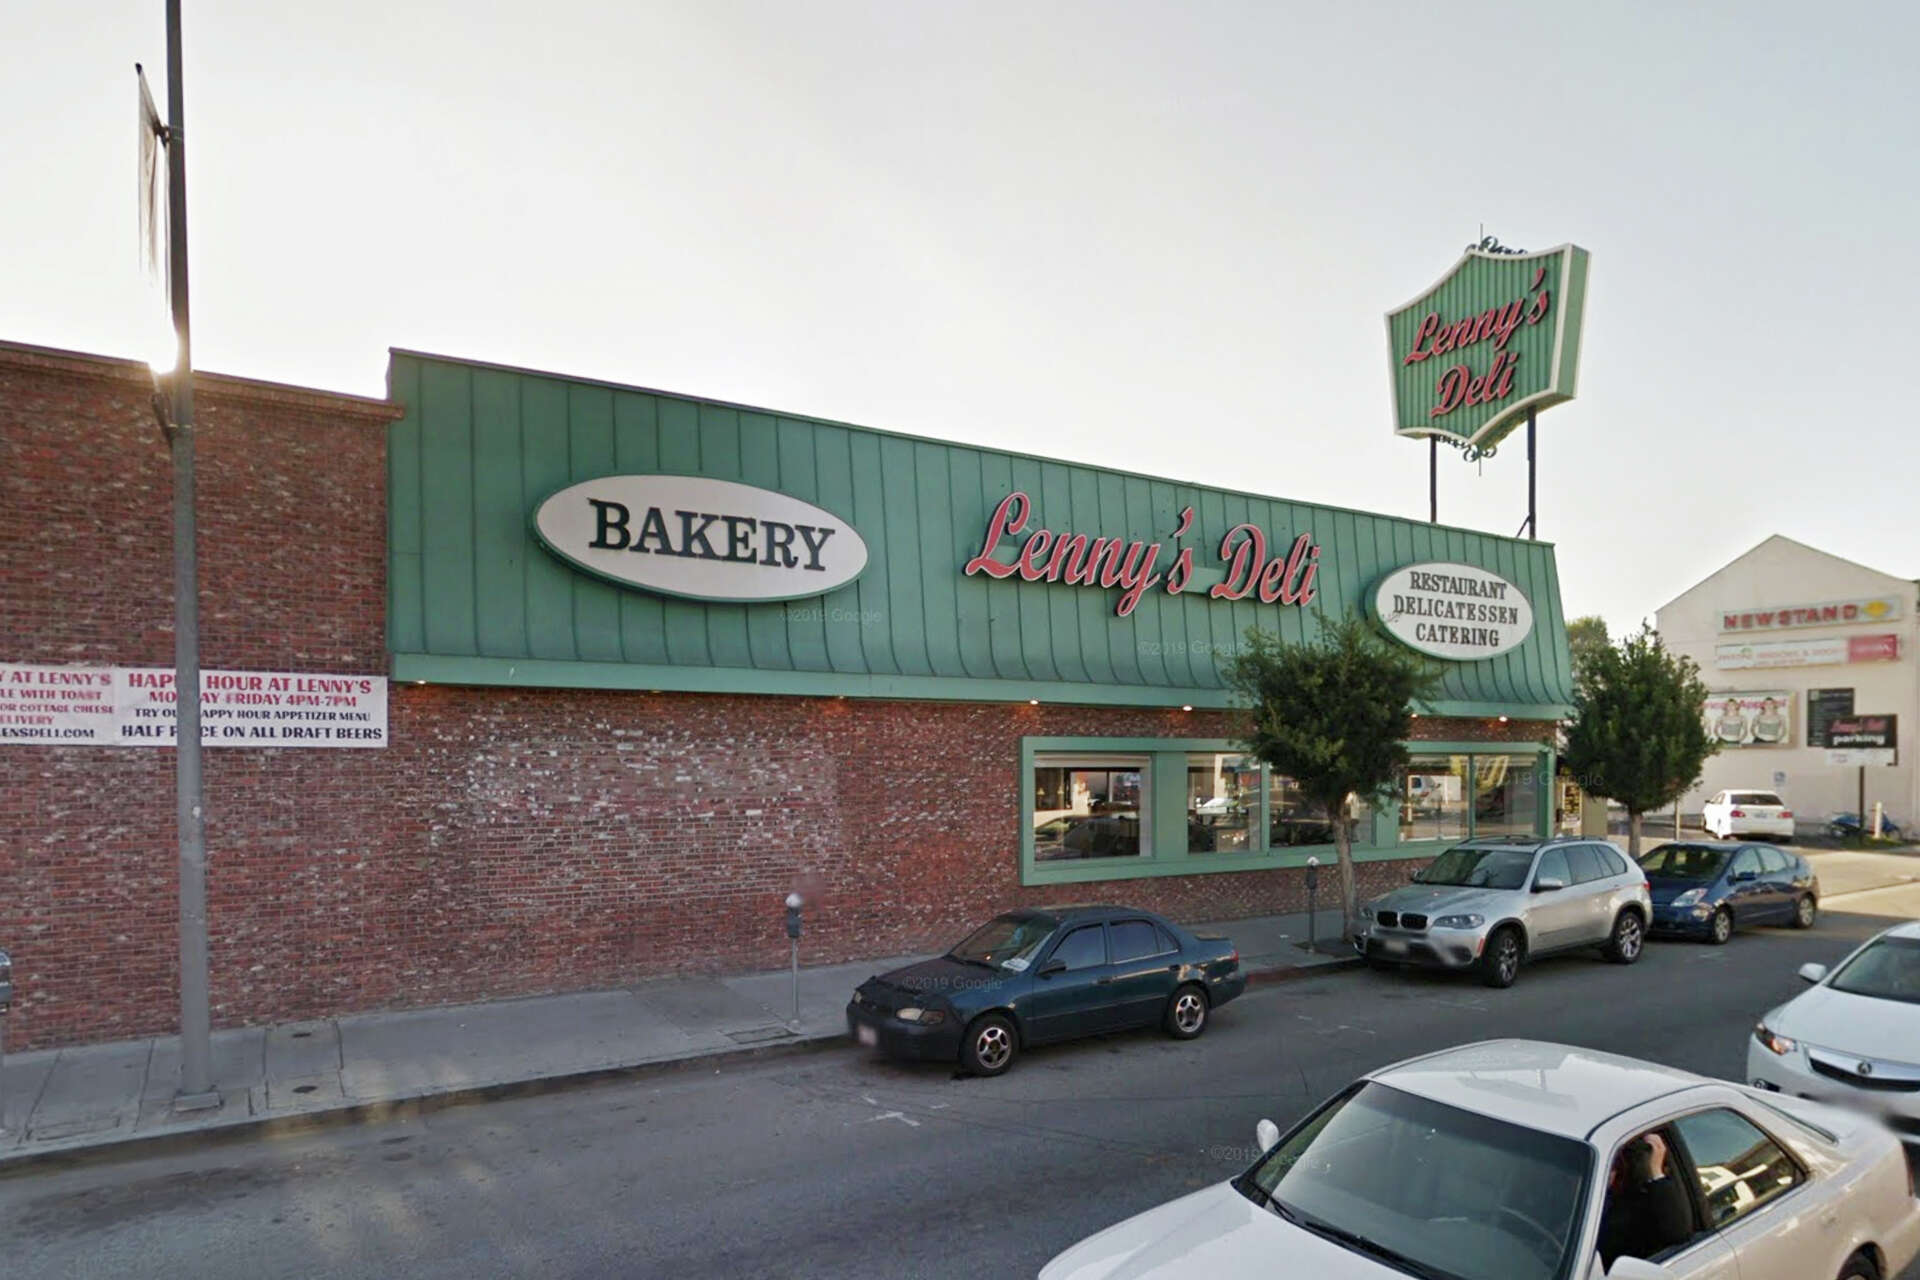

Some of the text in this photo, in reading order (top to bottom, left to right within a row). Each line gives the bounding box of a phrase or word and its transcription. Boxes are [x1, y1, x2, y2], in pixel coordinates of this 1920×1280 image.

[1403, 267, 1549, 365] Lenny's
[1430, 351, 1520, 418] Deli
[586, 497, 836, 572] BAKERY
[965, 491, 1321, 617] Lenny's Deli
[1409, 570, 1508, 600] RESTAURANT
[1393, 594, 1519, 625] DELICATESSEN
[1723, 604, 1858, 630] NEWSTAND
[1415, 622, 1501, 647] CATERING
[11, 671, 32, 683] AT
[39, 671, 112, 685] LENNY'S
[128, 673, 371, 694] HAP HOUR AT LENNY'S
[20, 689, 56, 699] WITH
[226, 693, 282, 705] FRIDAY
[135, 708, 158, 718] TRY
[237, 710, 271, 719] HOUR
[274, 711, 337, 721] APPETIZER
[339, 712, 371, 721] MENU
[122, 725, 164, 737] HALF
[223, 726, 245, 738] ON
[250, 726, 278, 738] ALL
[282, 726, 331, 739] DRAFT
[336, 727, 383, 739] BEERS
